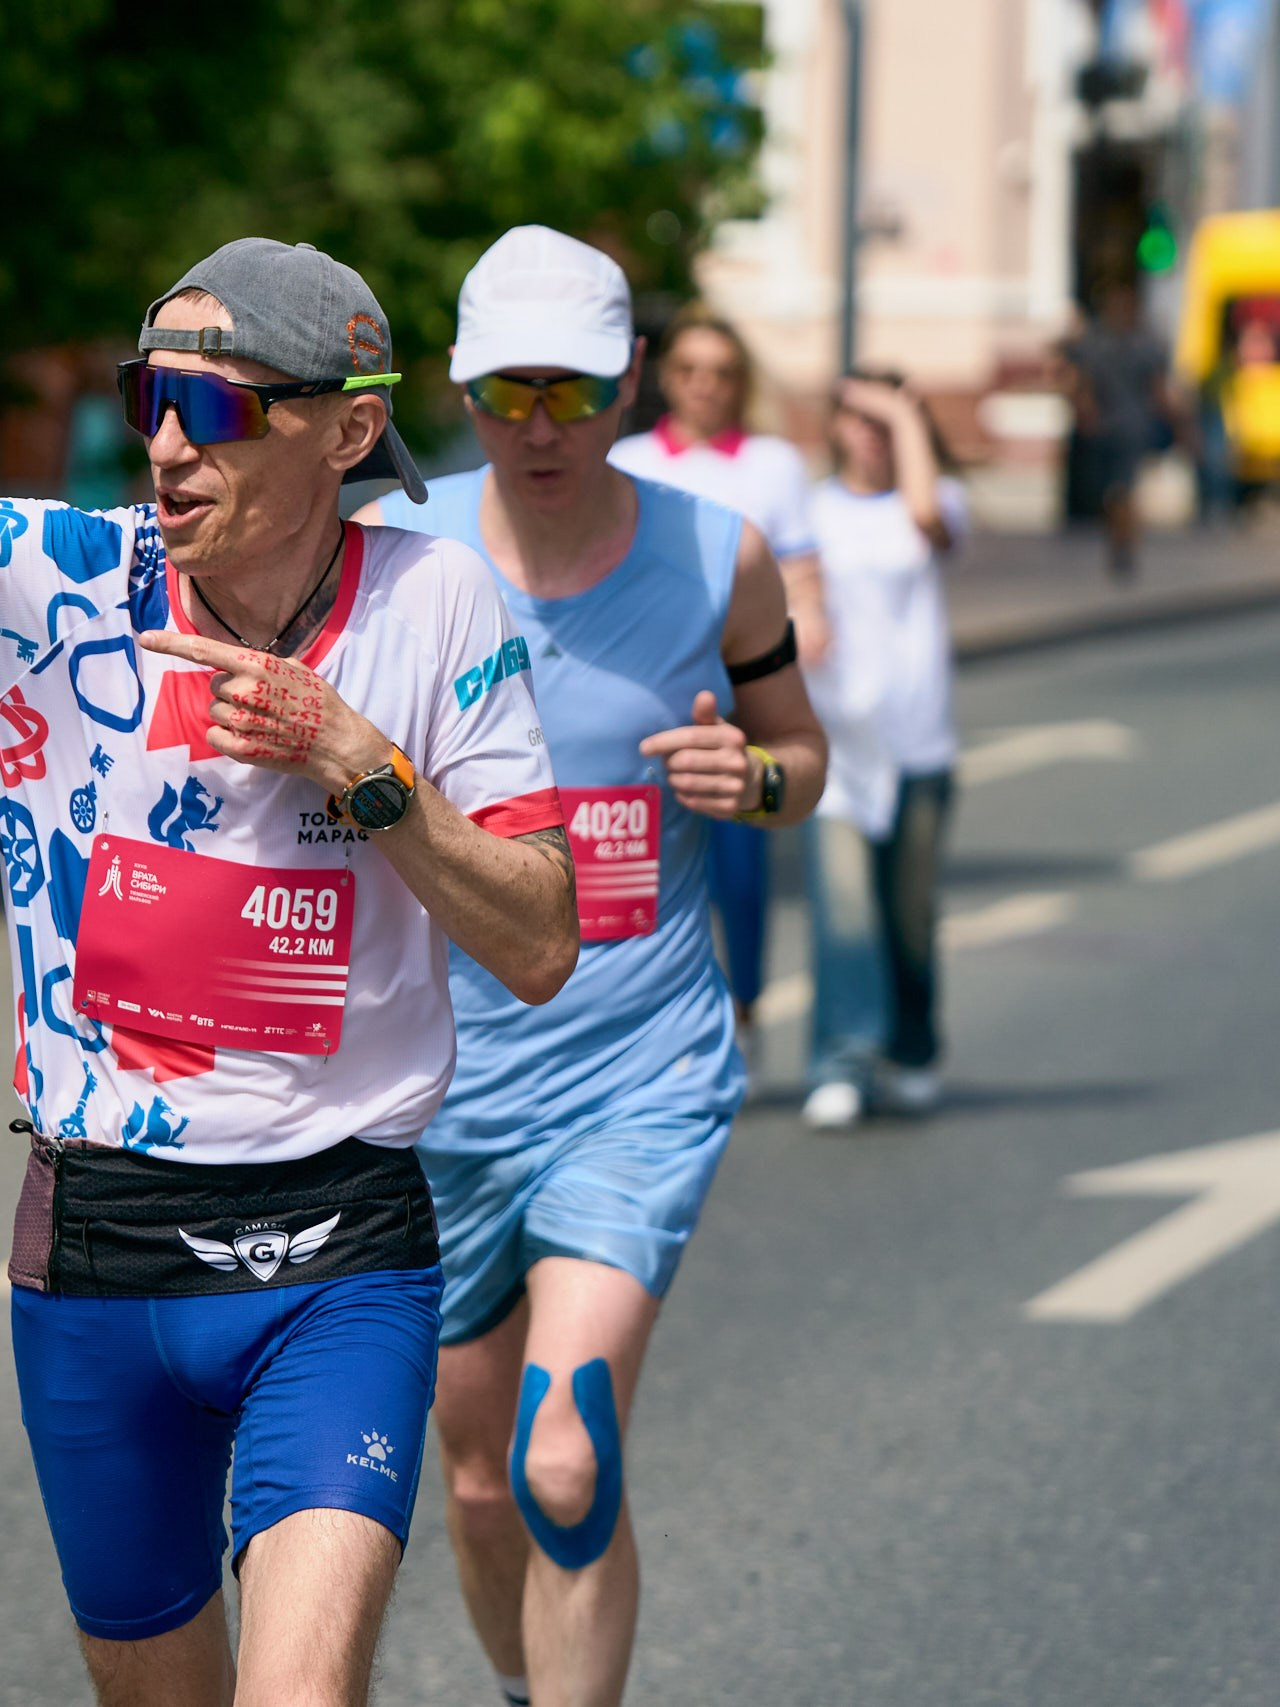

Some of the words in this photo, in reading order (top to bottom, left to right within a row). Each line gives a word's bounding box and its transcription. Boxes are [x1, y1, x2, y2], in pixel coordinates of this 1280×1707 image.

[453, 636, 532, 712] СИБУ
[299, 812, 346, 827] ТОБ
[569, 798, 650, 842] 4020
[130, 879, 167, 895] СИБИРИ
[131, 870, 158, 883] ВРАТА
[240, 885, 339, 932] 4059
[268, 936, 305, 956] 42,2
[308, 937, 335, 957] КМ
[196, 1017, 215, 1027] ВТБ
[249, 1242, 277, 1263] G
[346, 1453, 399, 1483] KELME
